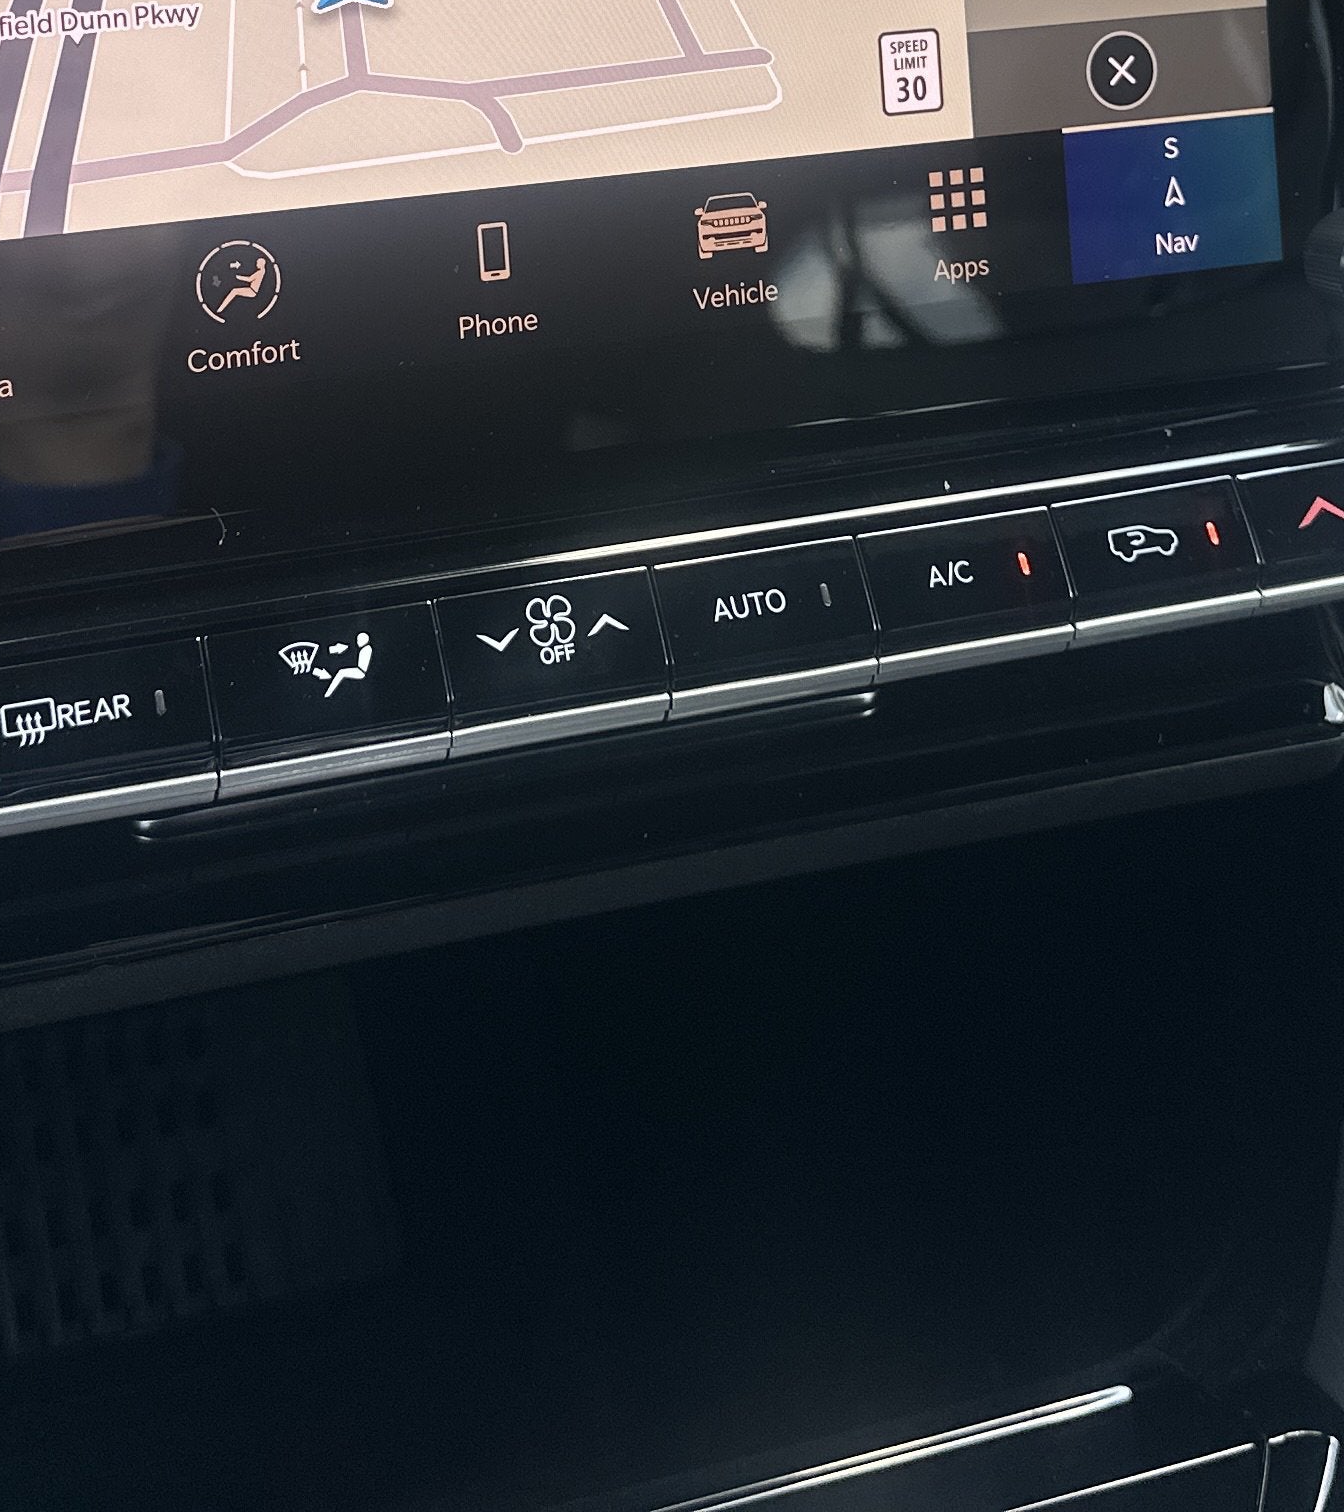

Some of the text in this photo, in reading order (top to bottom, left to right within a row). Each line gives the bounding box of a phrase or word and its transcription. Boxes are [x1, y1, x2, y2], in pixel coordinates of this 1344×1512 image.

[59, 6, 128, 34] Dunn
[132, 3, 201, 33] Pkwy
[889, 38, 928, 55] SPEED
[893, 55, 928, 71] LIMIT
[896, 75, 927, 103] 30
[1163, 136, 1179, 160] S
[1155, 230, 1199, 257] Nav
[934, 256, 991, 284] Apps
[692, 280, 779, 310] Vehicle
[458, 308, 539, 340] Phone
[187, 338, 301, 376] Comfort
[927, 558, 974, 590] A/C
[713, 587, 787, 621] AUTO
[539, 643, 576, 665] OFF
[58, 694, 133, 728] REAR
